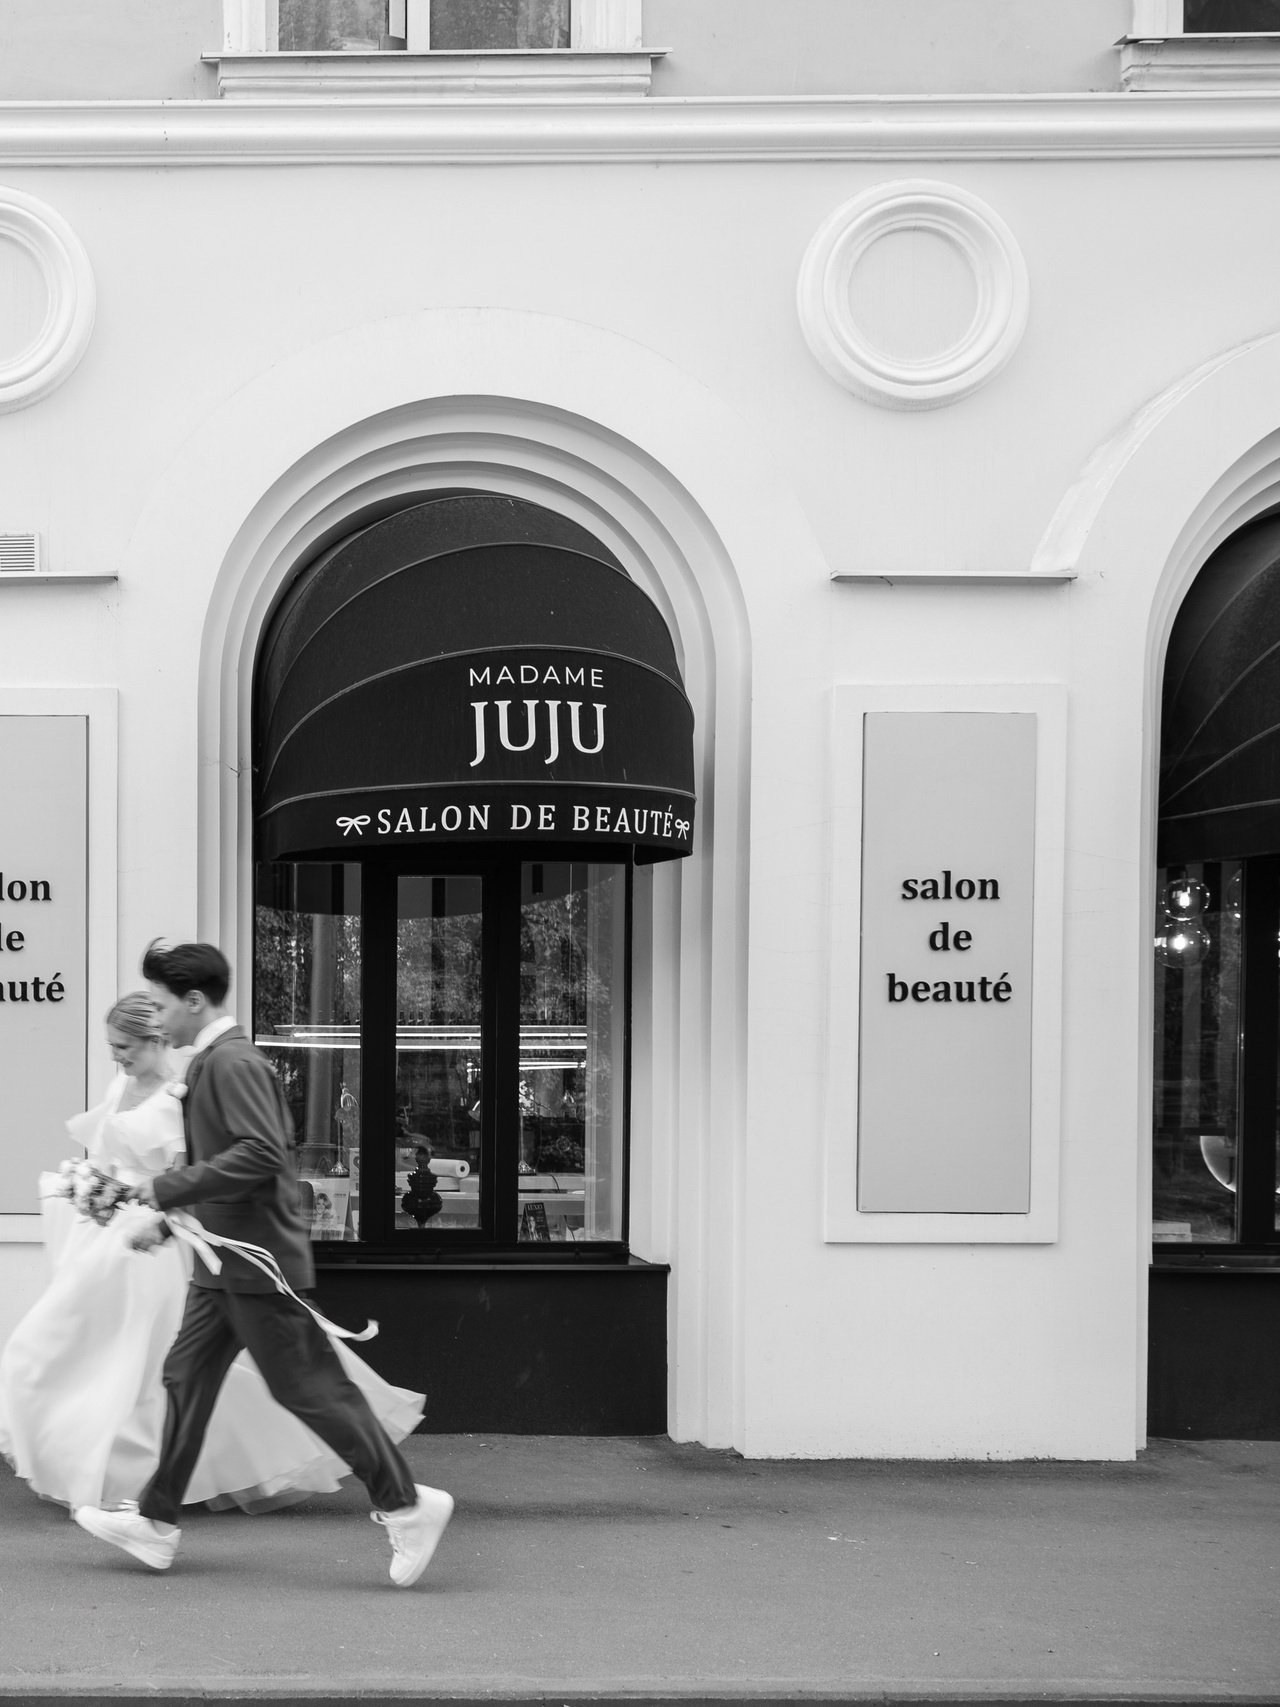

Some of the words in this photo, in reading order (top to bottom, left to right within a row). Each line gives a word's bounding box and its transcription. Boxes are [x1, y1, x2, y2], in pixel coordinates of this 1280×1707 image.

[469, 665, 604, 688] MADAME
[469, 699, 607, 767] JUJU
[377, 804, 491, 835] SALON
[510, 804, 556, 830] DE
[572, 804, 673, 838] BEAUTÉ
[901, 870, 1001, 901] salon
[928, 921, 973, 952] de
[886, 972, 1013, 1003] beauté
